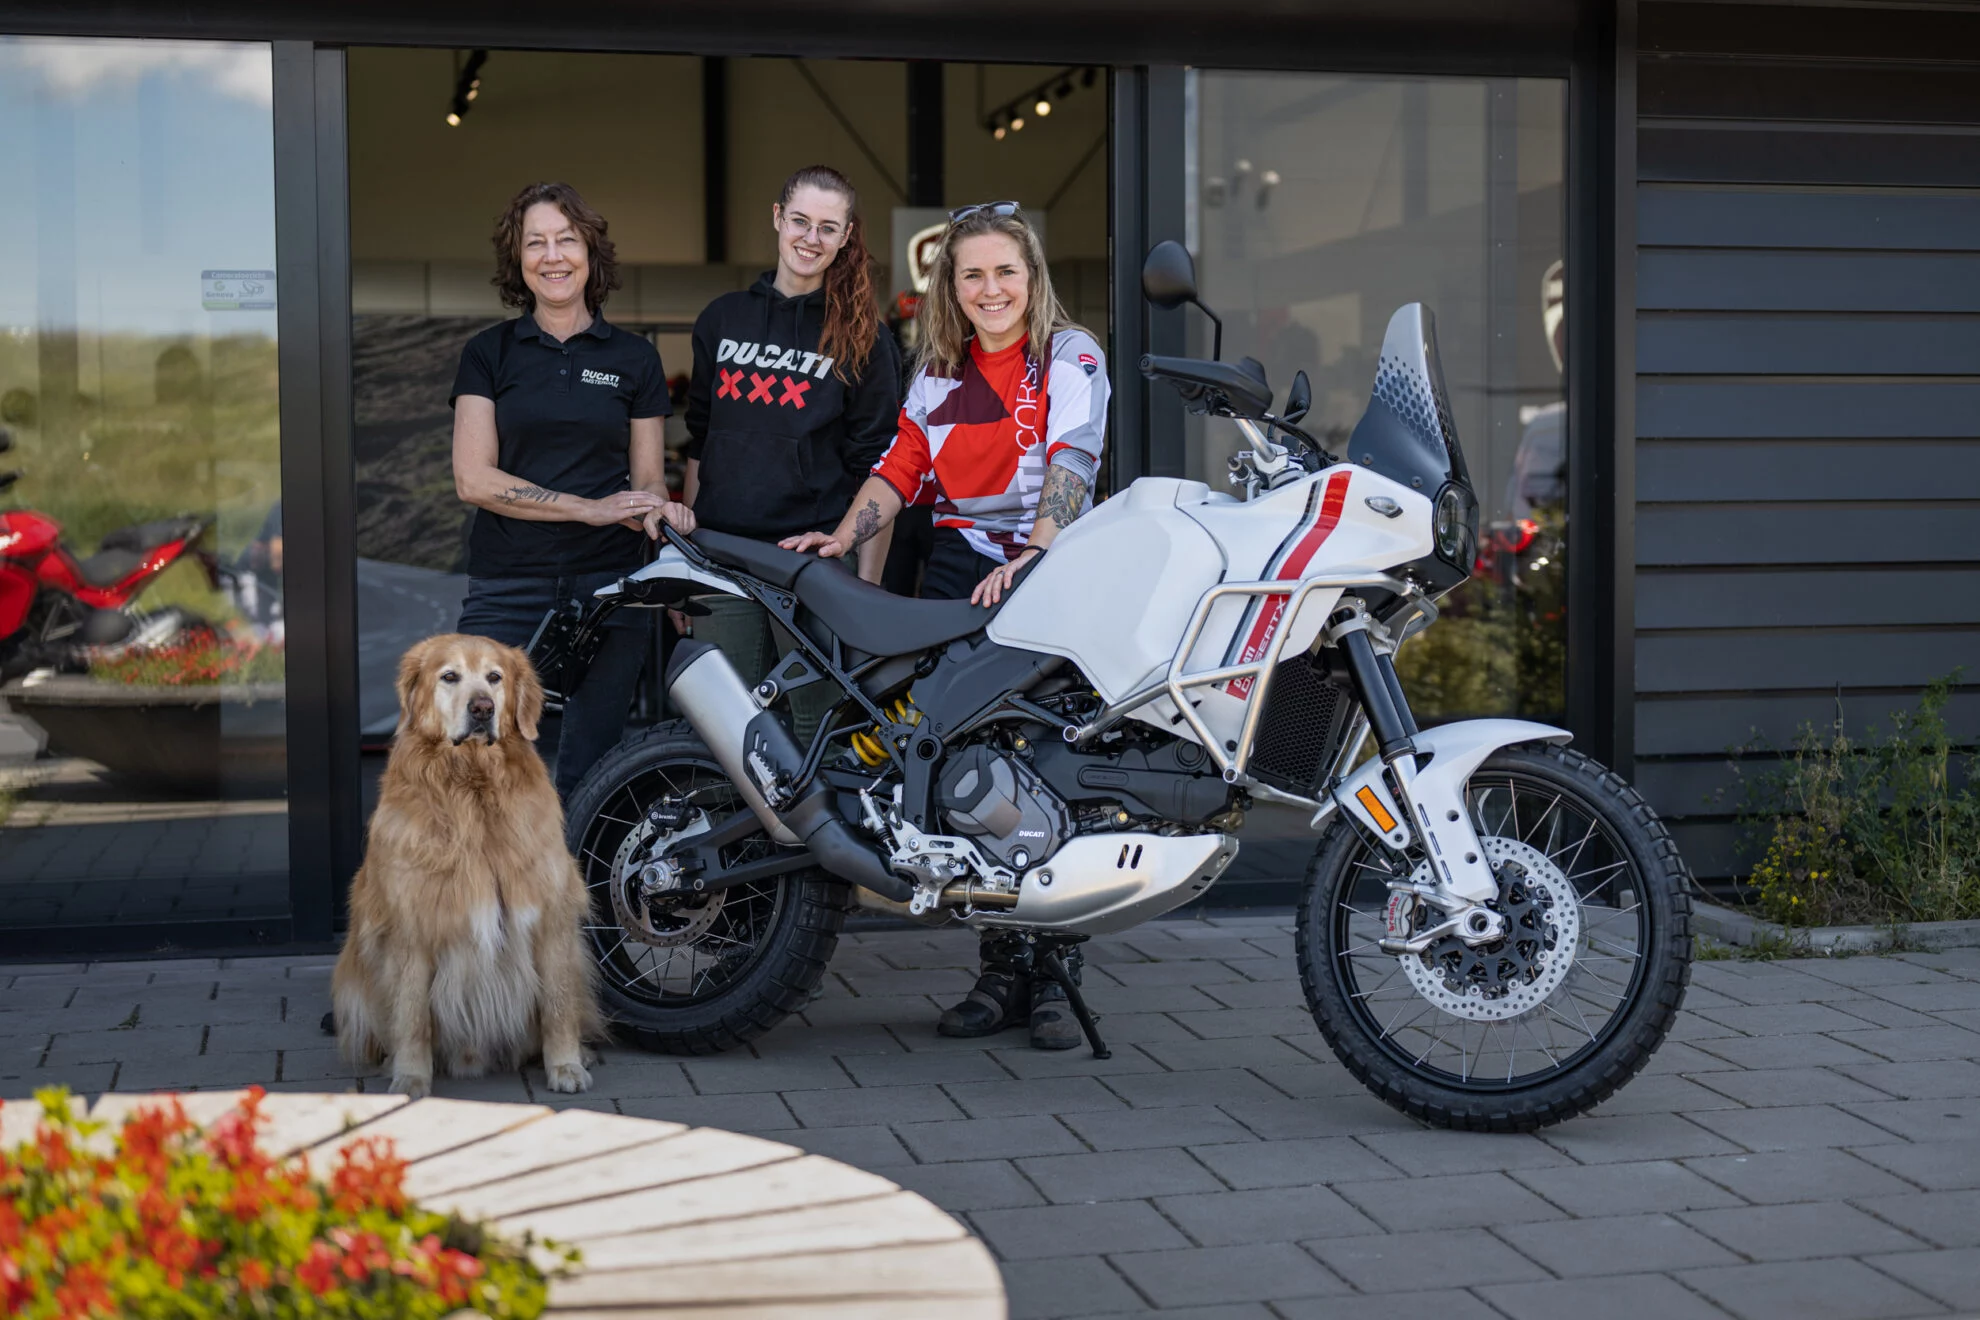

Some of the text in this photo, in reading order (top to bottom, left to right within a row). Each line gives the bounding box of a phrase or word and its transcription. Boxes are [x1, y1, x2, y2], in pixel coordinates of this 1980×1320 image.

[581, 369, 620, 382] DUCATI
[717, 338, 834, 379] DUCATI
[580, 377, 619, 388] AMSTERDAM
[1240, 595, 1287, 693] DSERTX
[1233, 646, 1256, 689] DATI
[1018, 830, 1045, 838] DUCATI
[1388, 896, 1399, 932] brembo
